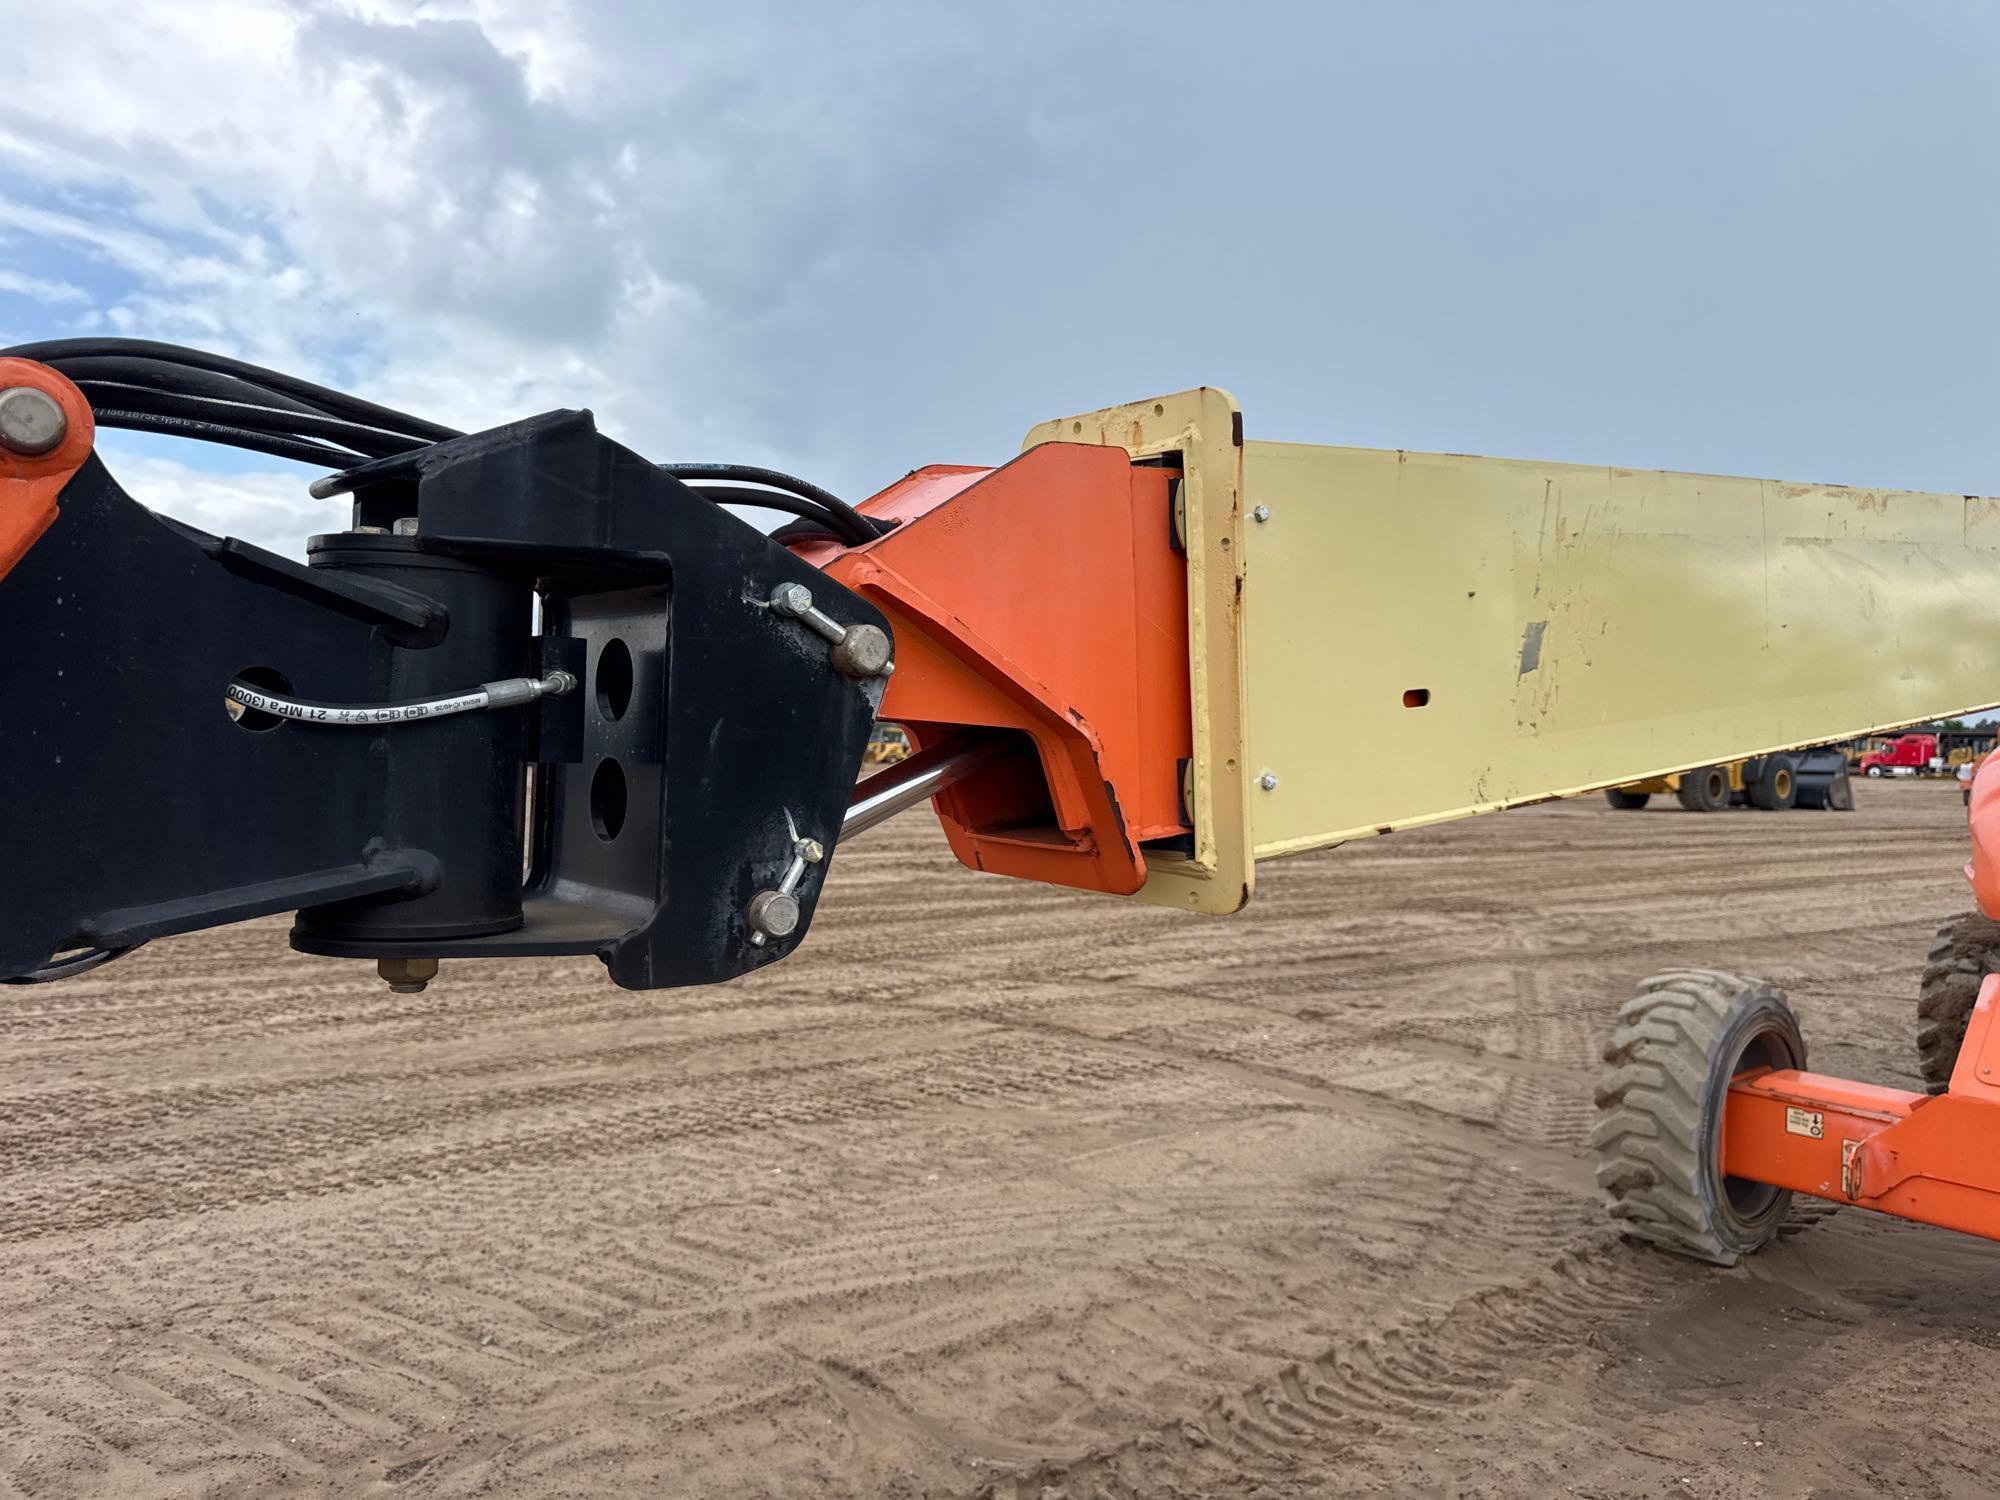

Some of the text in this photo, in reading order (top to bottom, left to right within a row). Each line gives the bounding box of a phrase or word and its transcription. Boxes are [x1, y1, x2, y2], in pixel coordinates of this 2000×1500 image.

[107, 409, 125, 417] ISO
[160, 415, 181, 425] Type
[227, 686, 265, 707] (3000
[269, 701, 303, 717] MPa
[309, 709, 327, 721] 21
